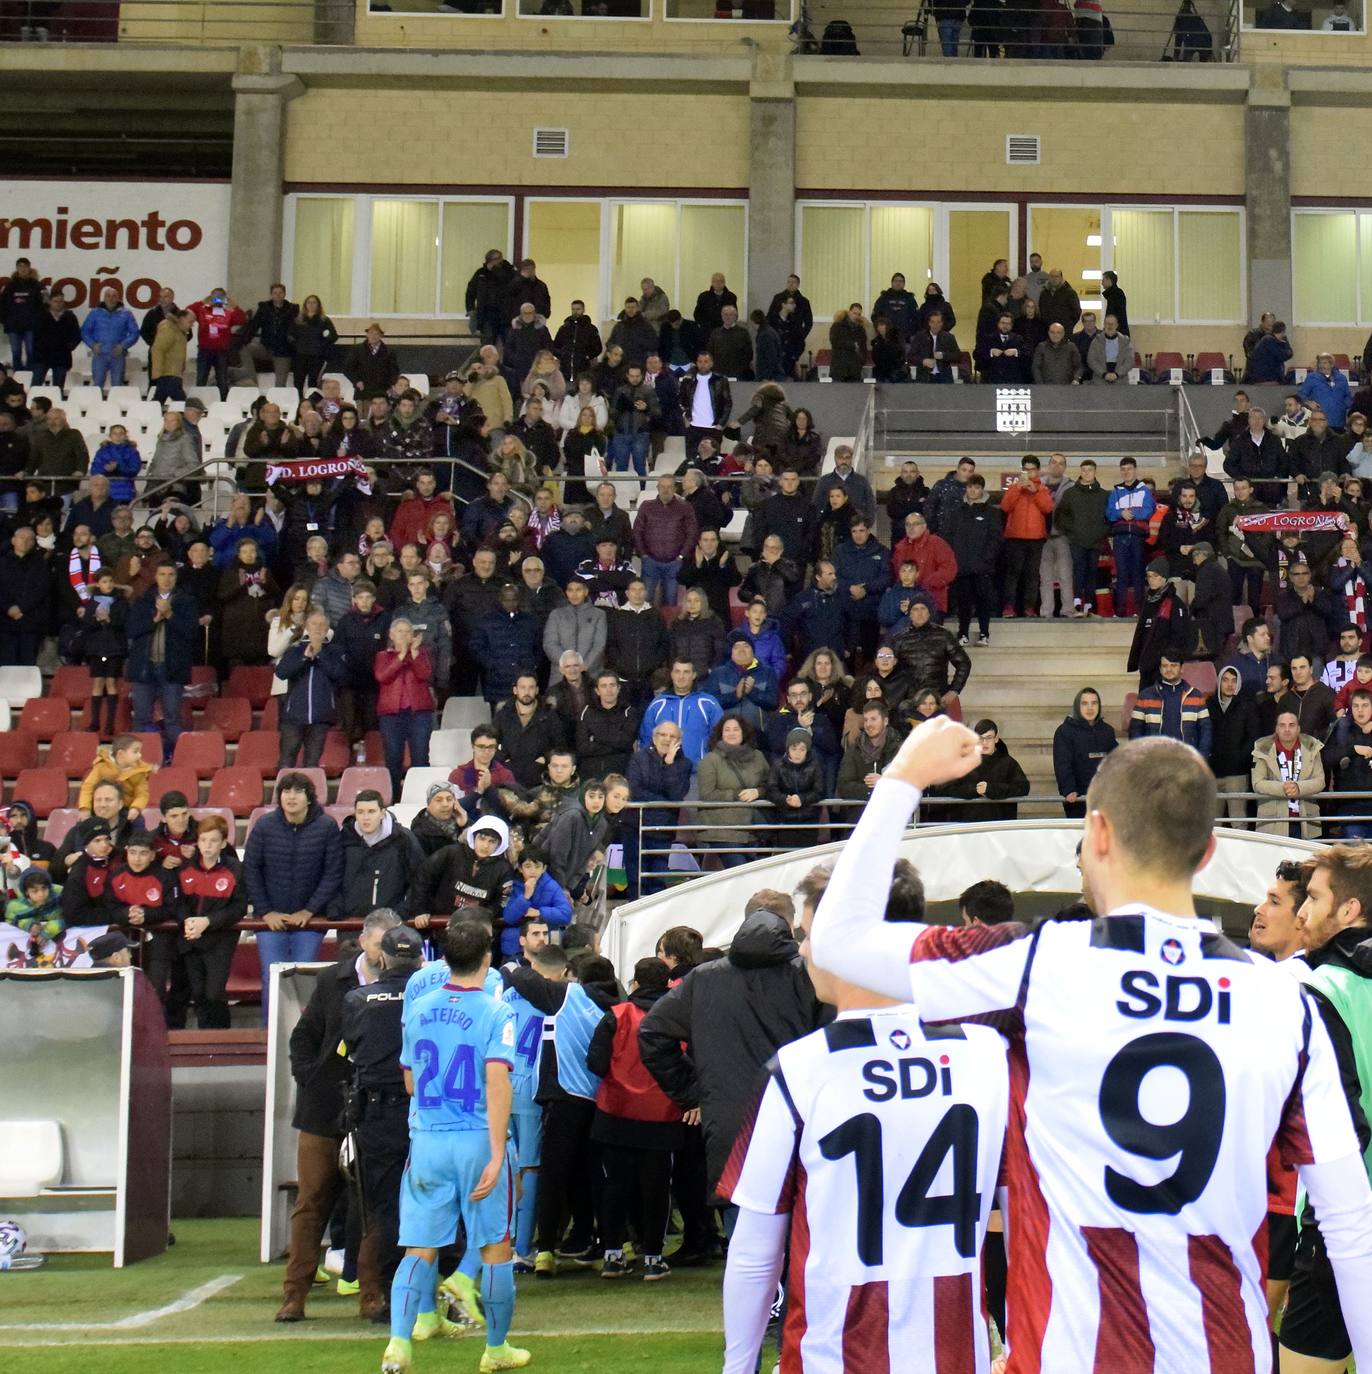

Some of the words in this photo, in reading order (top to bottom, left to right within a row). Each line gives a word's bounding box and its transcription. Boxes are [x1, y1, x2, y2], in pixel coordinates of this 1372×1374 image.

[366, 991, 405, 1003] POLI
[1115, 969, 1232, 1025] SDi
[514, 1012, 545, 1068] 4
[414, 1038, 481, 1113] 24
[861, 1053, 953, 1103] SDi
[1098, 1031, 1227, 1217] 9
[817, 1102, 982, 1267] 14
